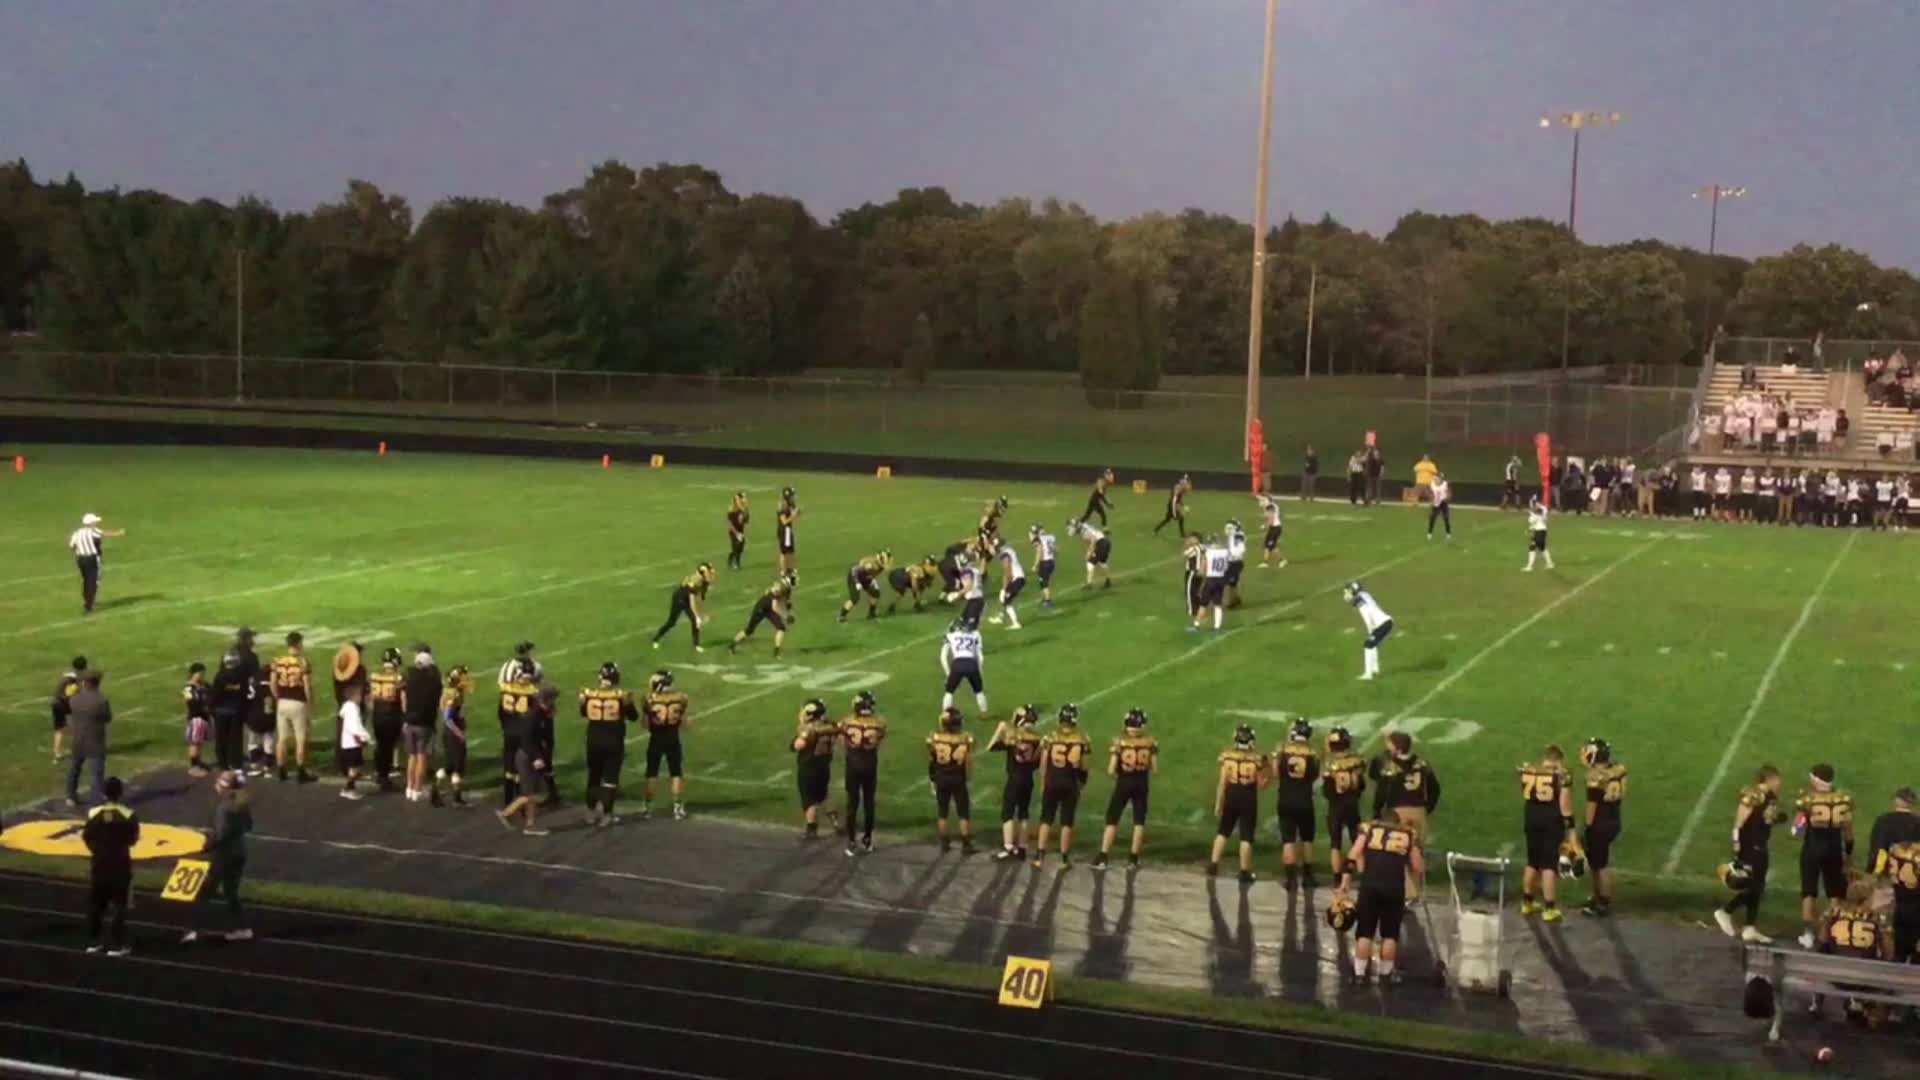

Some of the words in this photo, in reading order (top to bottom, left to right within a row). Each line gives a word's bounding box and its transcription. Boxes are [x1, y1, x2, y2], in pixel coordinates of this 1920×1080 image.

[954, 636, 974, 651] 22
[586, 699, 620, 721] 62
[1050, 743, 1082, 768] 64
[1287, 756, 1307, 779] 3
[1520, 774, 1554, 801] 75
[1367, 828, 1409, 855] 12
[168, 866, 205, 895] 30
[1831, 918, 1876, 948] 45
[1004, 965, 1045, 1001] 40
